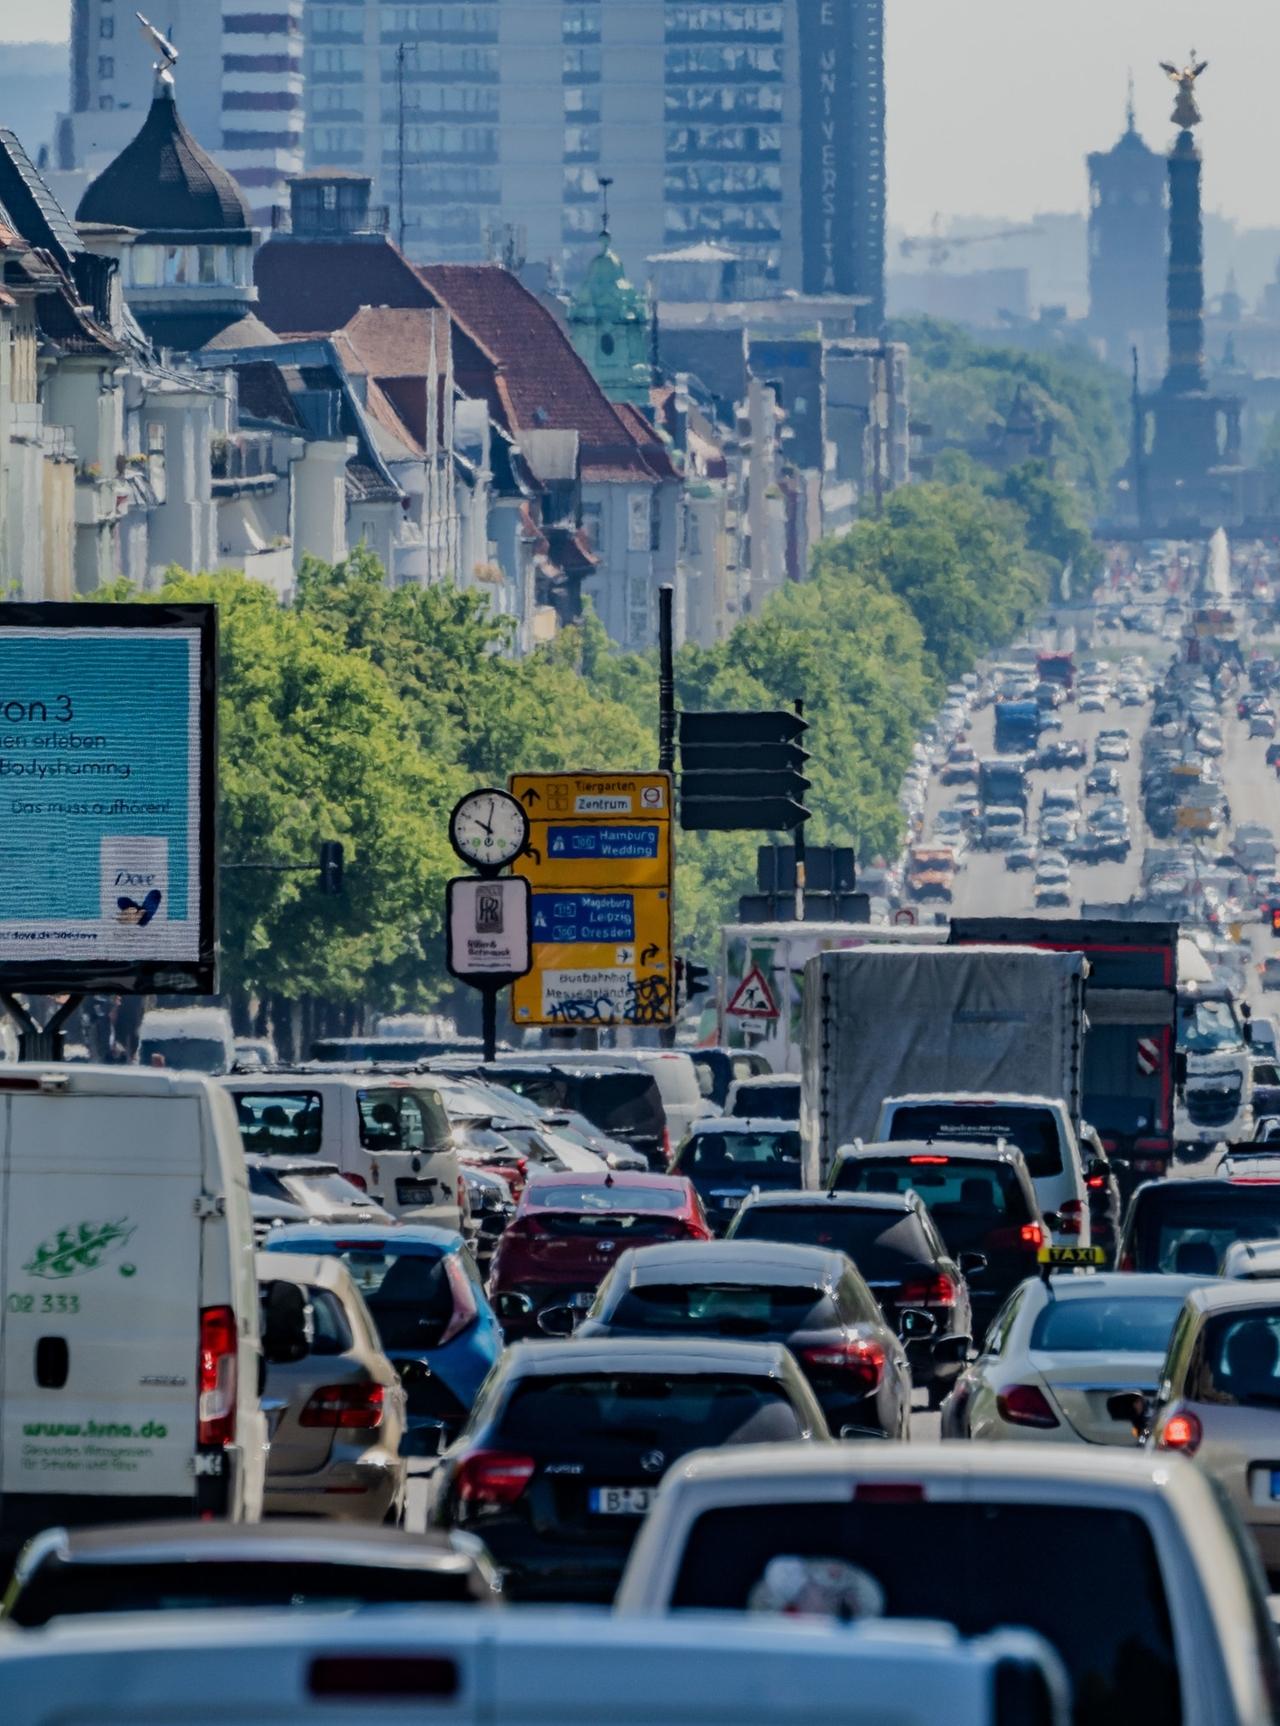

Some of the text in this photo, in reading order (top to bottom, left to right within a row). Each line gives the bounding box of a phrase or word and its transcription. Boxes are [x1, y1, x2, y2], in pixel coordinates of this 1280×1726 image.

[0, 694, 73, 722] on 3
[33, 732, 106, 749] erleben
[575, 781, 636, 794] Tiergarten
[578, 798, 629, 810] Zentrum
[599, 831, 656, 844] Hamburg
[601, 844, 653, 857] Wedding
[114, 871, 156, 886] Dove
[581, 896, 632, 909] Magdeburg
[589, 911, 632, 925] Leipzig
[581, 926, 632, 938] Dresden
[559, 972, 632, 984] Busbahnhof
[1052, 1249, 1095, 1261] TAXI
[40, 1294, 81, 1314] 333
[606, 1492, 620, 1512] B
